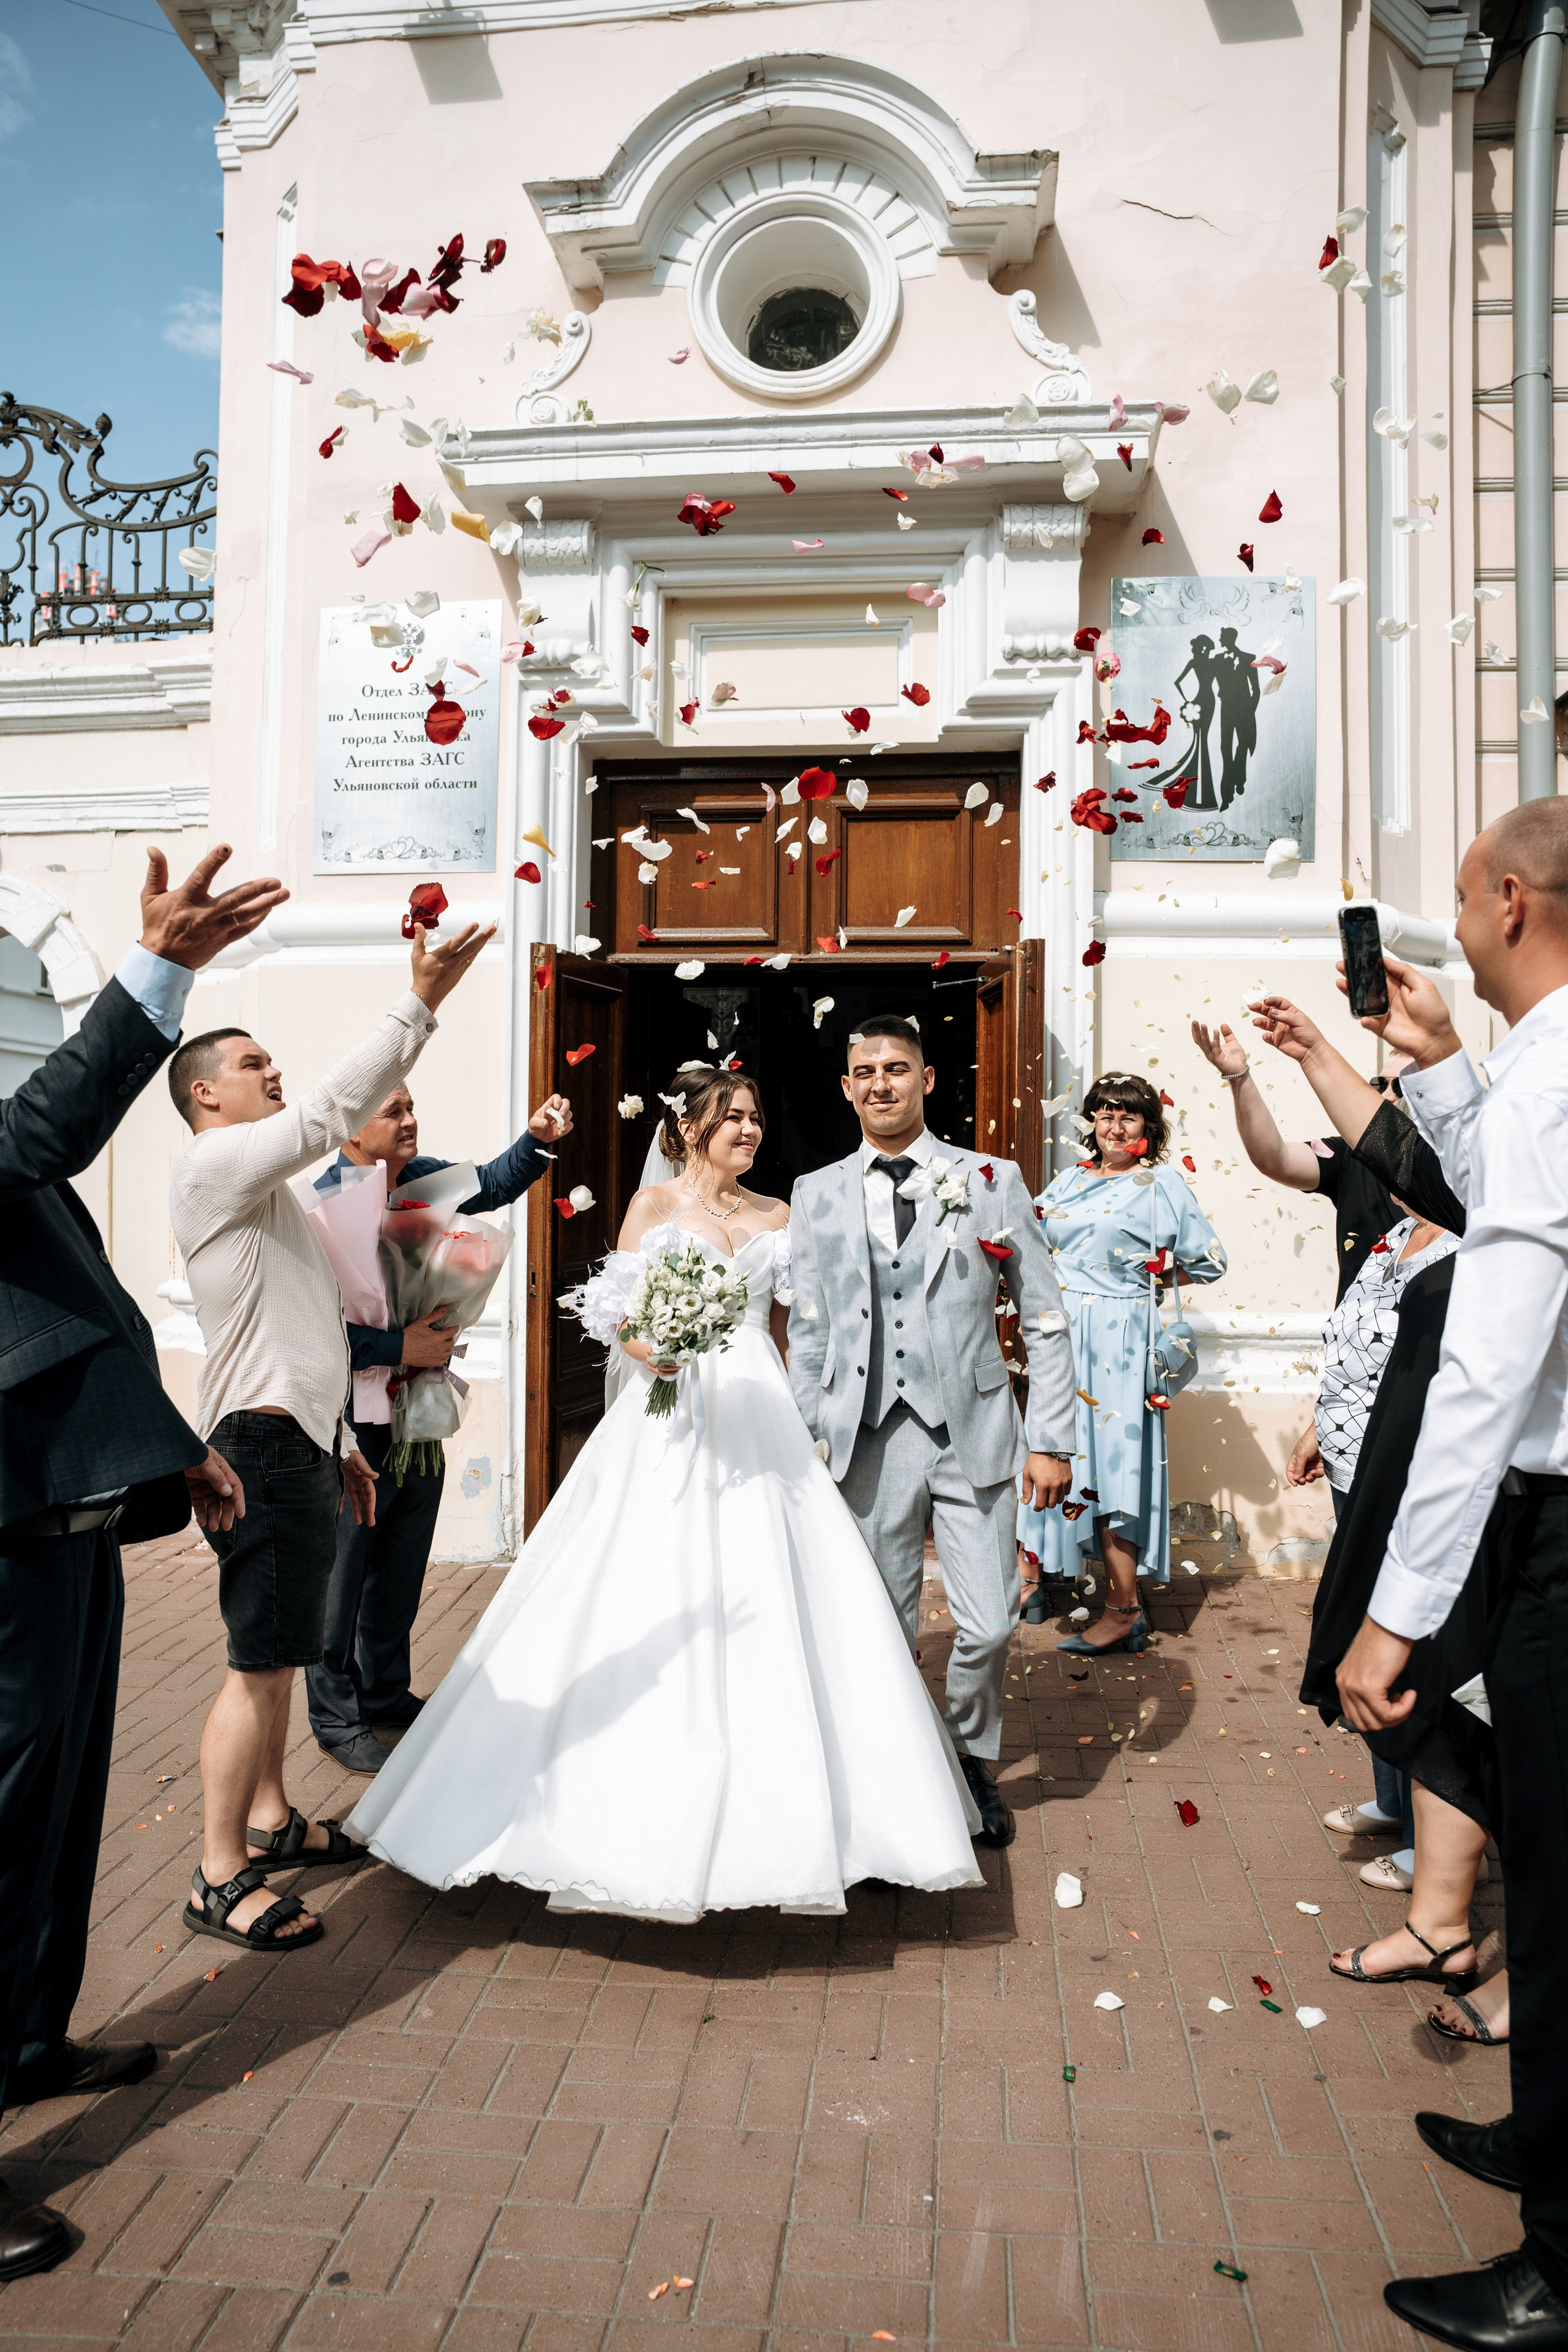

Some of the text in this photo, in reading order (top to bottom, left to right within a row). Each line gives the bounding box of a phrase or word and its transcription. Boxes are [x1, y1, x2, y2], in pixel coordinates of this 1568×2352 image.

[361, 682, 453, 698] Отдел ЗАС
[328, 714, 344, 723] по
[342, 736, 387, 747] города
[345, 752, 465, 768] Агентства ЗАГС
[333, 777, 477, 792] Ульяновской области
